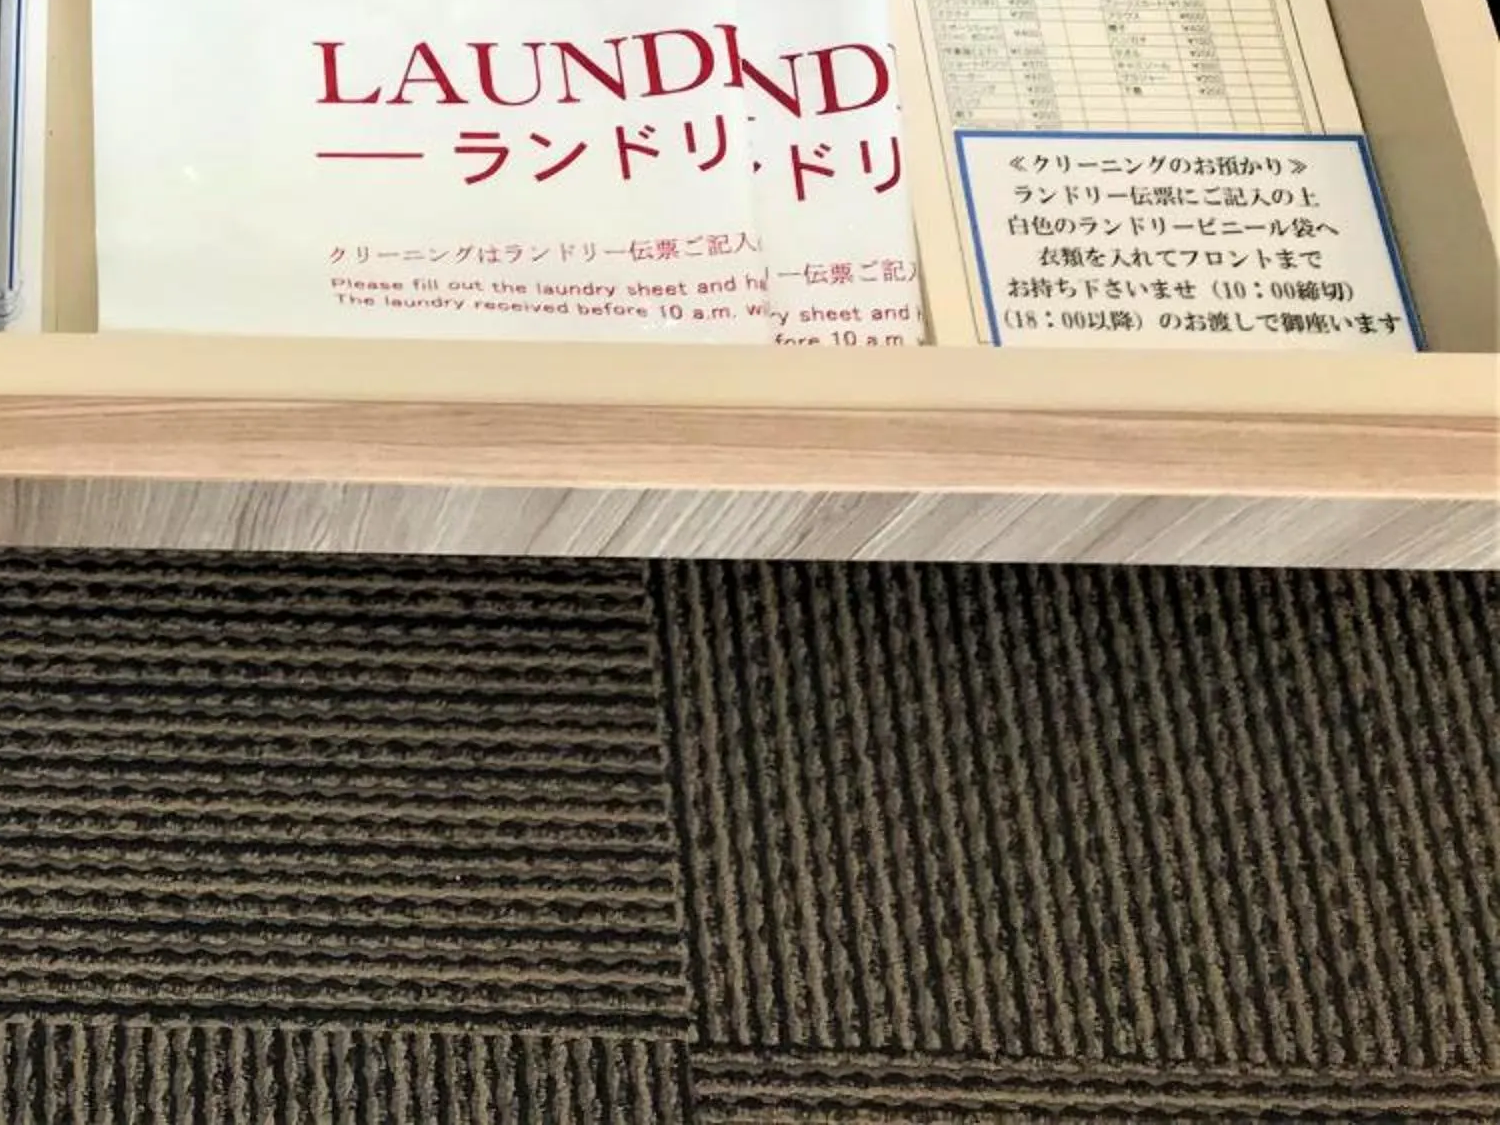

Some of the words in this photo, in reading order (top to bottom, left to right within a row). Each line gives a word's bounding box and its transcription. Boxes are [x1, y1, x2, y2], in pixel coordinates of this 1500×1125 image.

[1012, 185, 1320, 208] ランドリー伝票にご記入の上
[1007, 215, 1339, 238] 白色のランドリービニール袋へ
[1038, 246, 1323, 269] 衣類を入れてフロントまで
[330, 277, 403, 291] Please
[413, 277, 439, 291] fill
[448, 279, 484, 292] out
[492, 281, 527, 294] the
[536, 281, 616, 298] laundry
[627, 277, 688, 296] sheet
[697, 275, 737, 295] and
[335, 293, 375, 306] The
[385, 296, 465, 311] laundry
[474, 298, 569, 315] received
[578, 302, 648, 318] before
[660, 304, 683, 319] 10
[800, 305, 860, 323] sheet
[871, 304, 910, 321] and
[831, 331, 856, 346] 10
